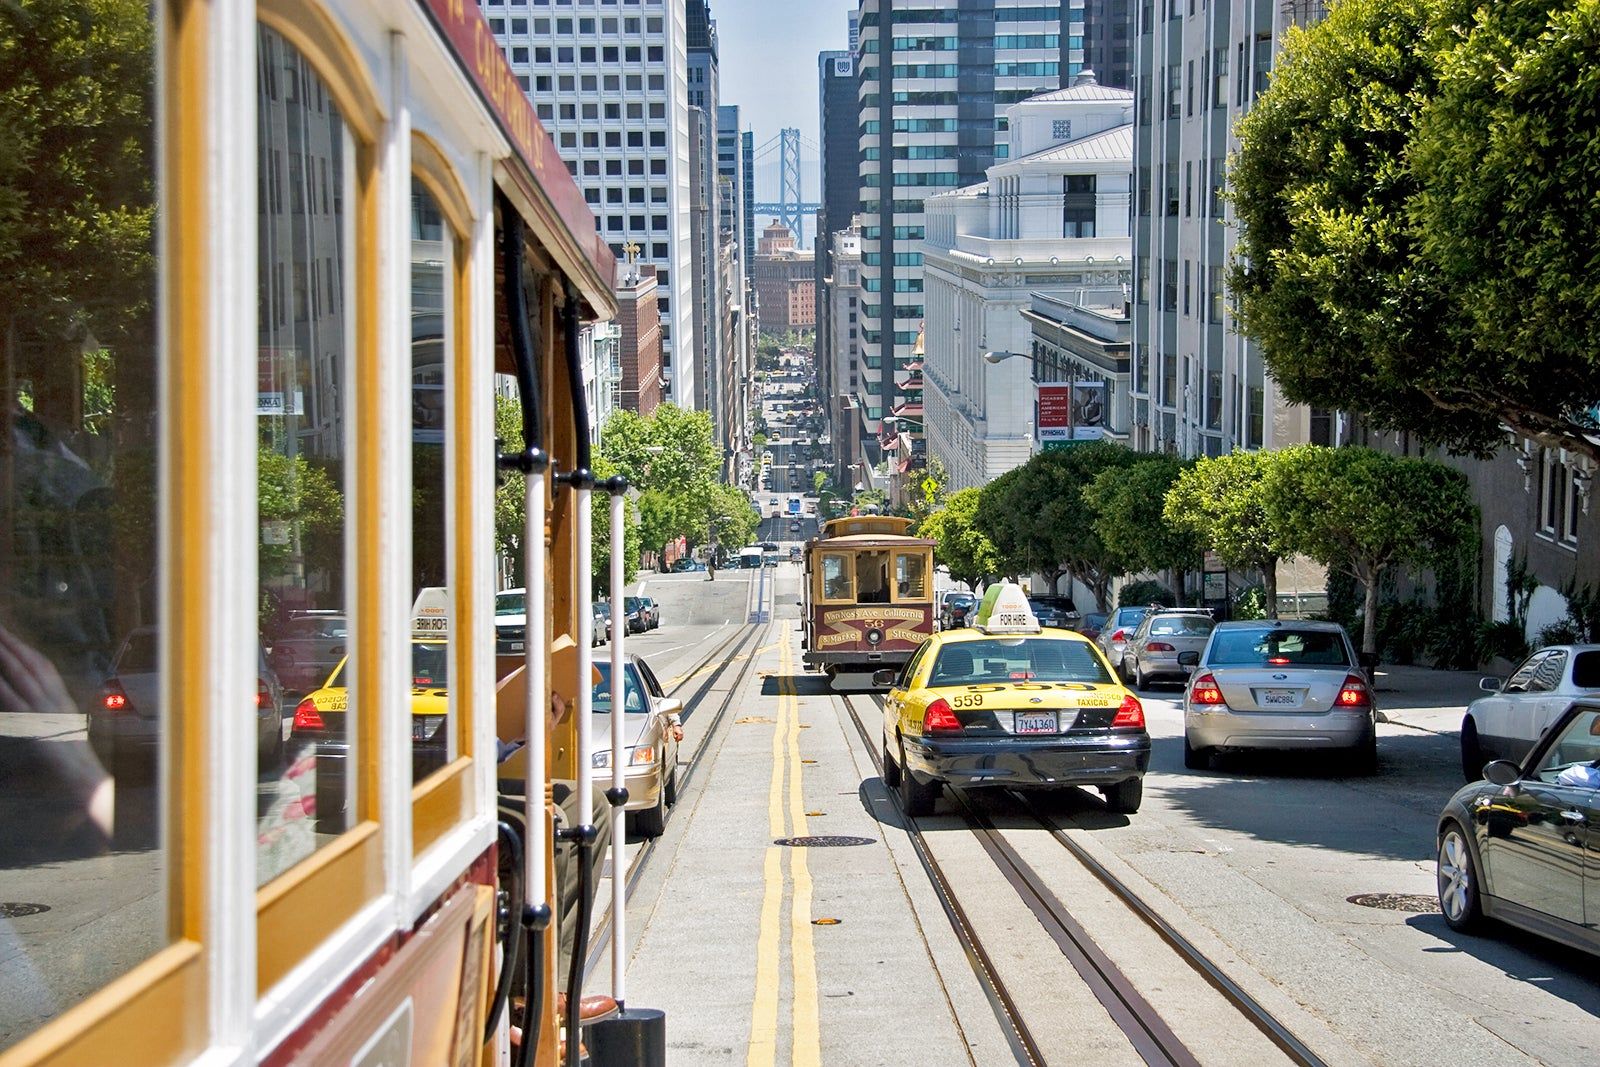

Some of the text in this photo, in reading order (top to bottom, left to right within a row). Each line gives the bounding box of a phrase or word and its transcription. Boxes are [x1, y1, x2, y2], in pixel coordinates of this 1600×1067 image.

[825, 612, 840, 620] Van
[840, 610, 860, 619] Ness
[884, 608, 924, 619] California
[1000, 614, 1026, 625] FOR HIRE
[830, 632, 857, 643] Marke
[893, 630, 927, 641] Streets
[954, 694, 983, 708] 559
[1019, 719, 1054, 729] 7Y41360
